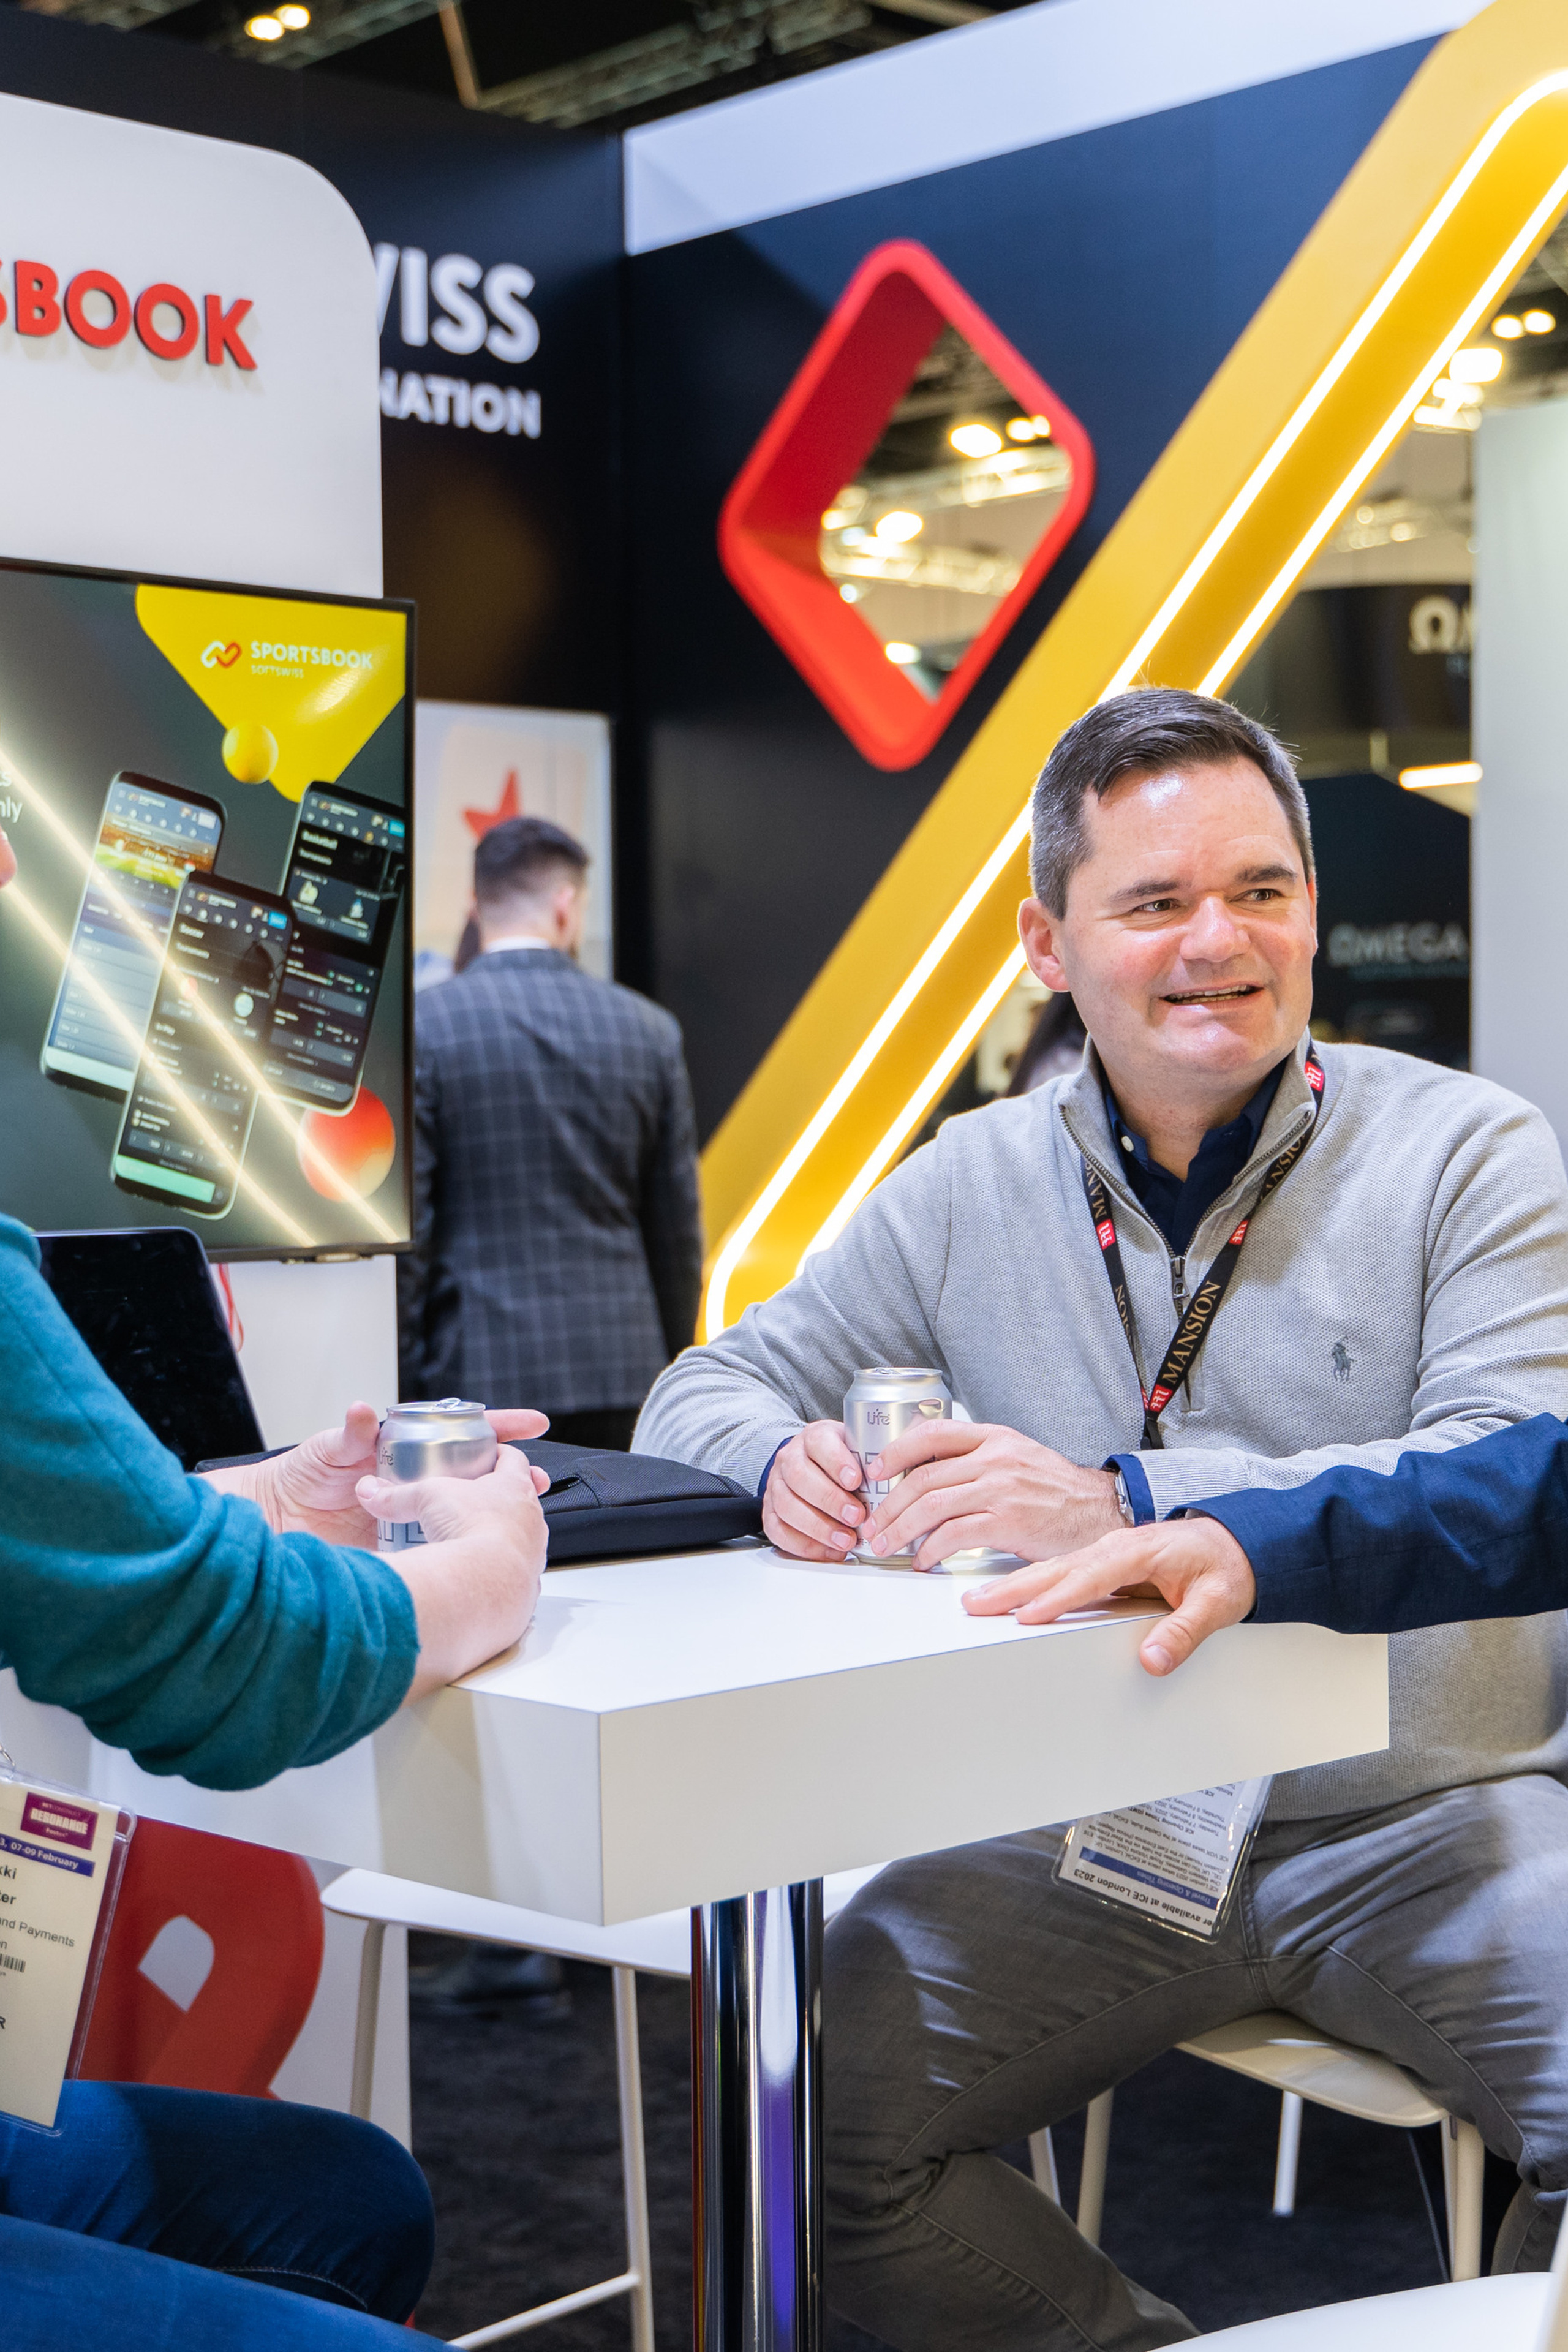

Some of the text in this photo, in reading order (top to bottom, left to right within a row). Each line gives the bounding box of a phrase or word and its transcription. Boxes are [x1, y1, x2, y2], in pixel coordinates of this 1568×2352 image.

[372, 242, 540, 364] ISS
[0, 259, 258, 371] BOOK
[251, 640, 373, 669] SPORTSBOOK
[251, 665, 304, 679] SOFTSWISS
[1162, 1280, 1222, 1385] MANSION
[30, 1807, 89, 1835] RESONANCE
[1144, 1811, 1161, 1821] Times
[1161, 1817, 1184, 1831] Opening
[11, 1842, 37, 1856] 07-09
[37, 1850, 79, 1870] February
[1073, 1868, 1095, 1882] 2023
[1095, 1877, 1131, 1896] London
[1156, 1877, 1185, 1894] Opening
[0, 1890, 17, 1905] er
[1132, 1891, 1149, 1903] ICE
[1149, 1898, 1159, 1907] at
[1160, 1902, 1201, 1923] available
[19, 1921, 75, 1947] Payments
